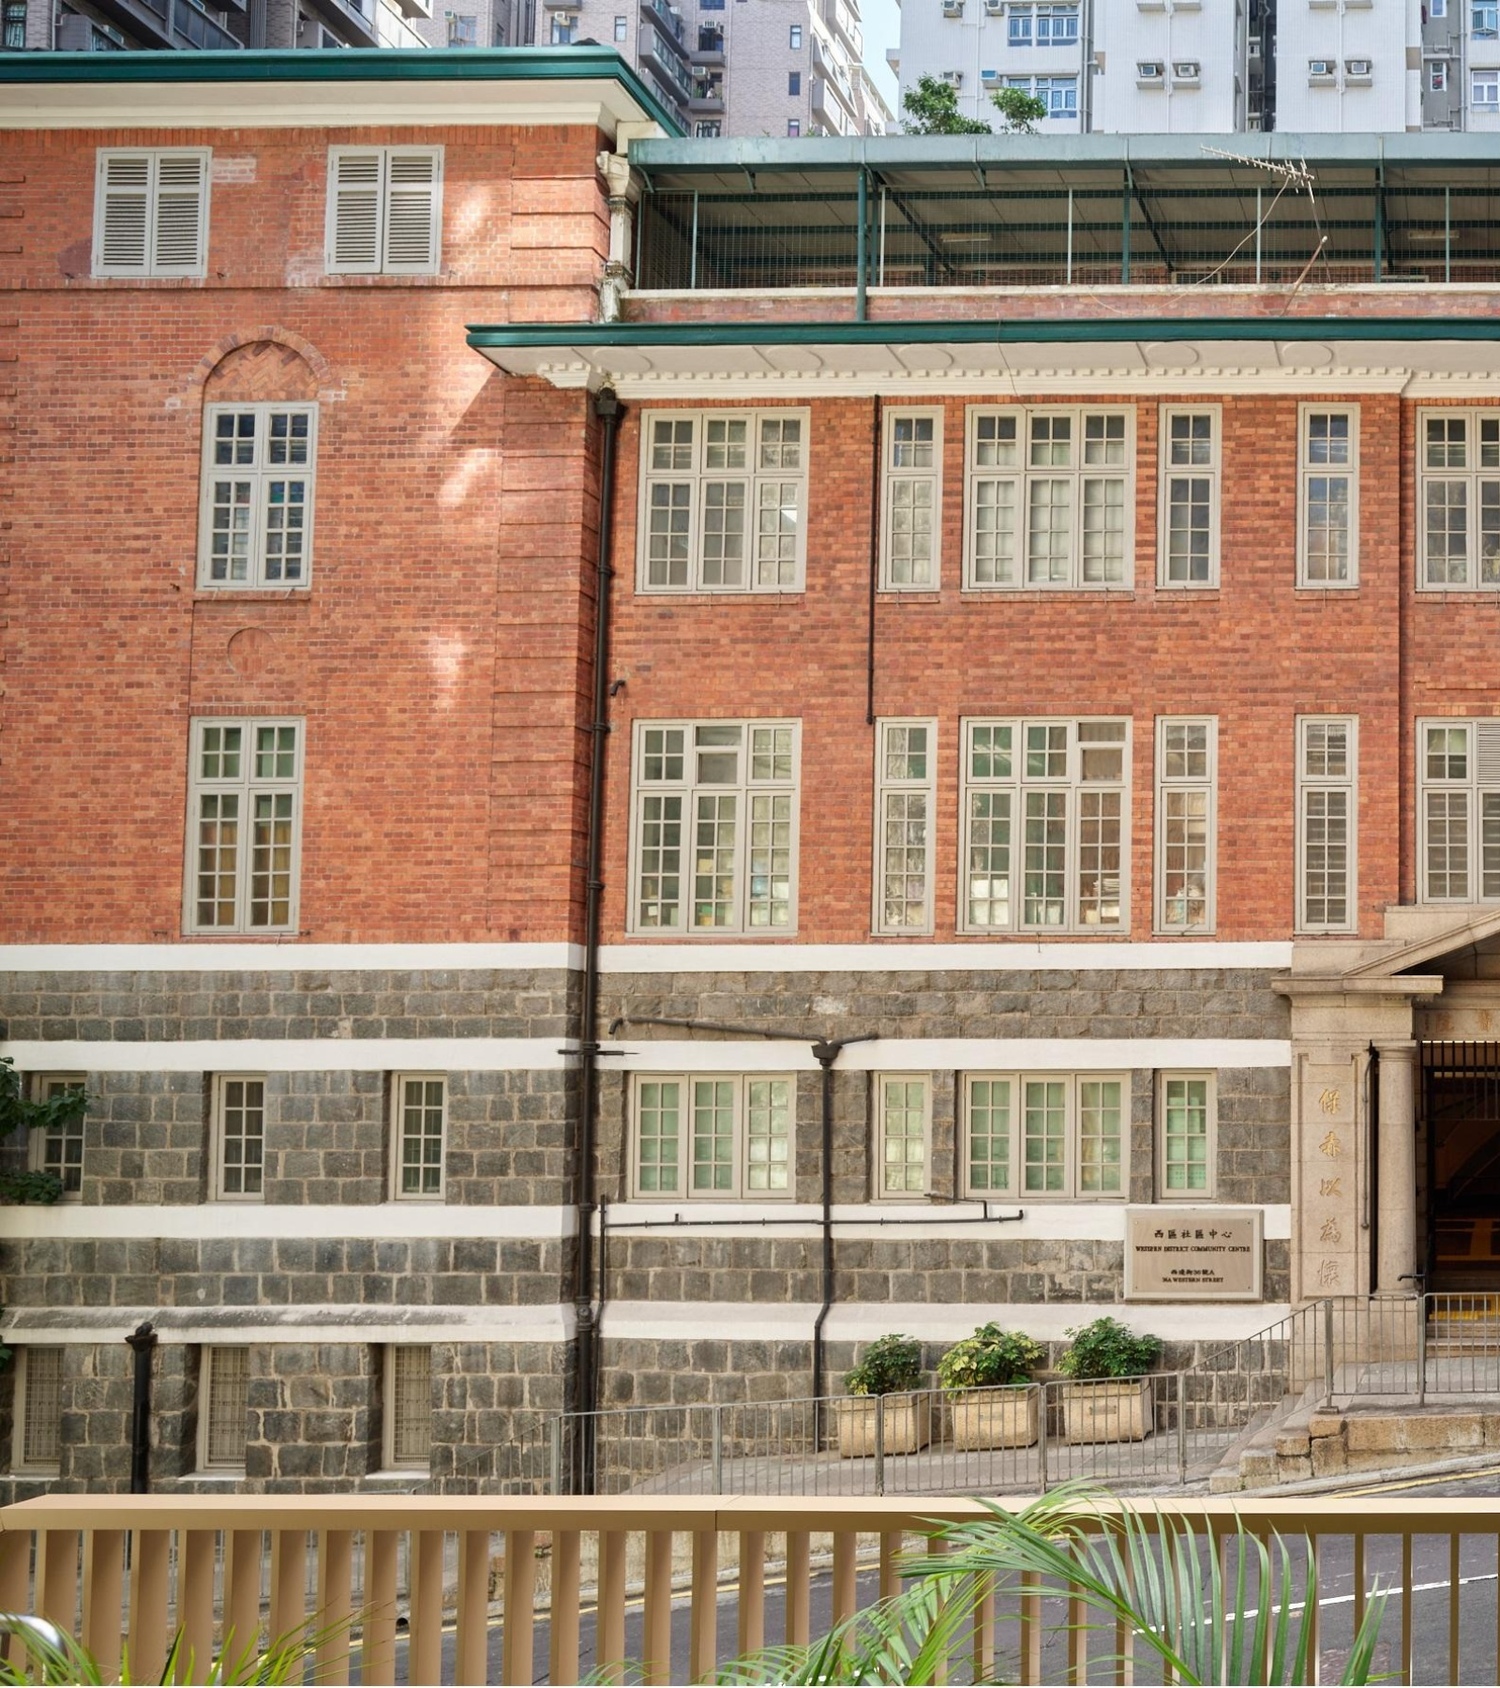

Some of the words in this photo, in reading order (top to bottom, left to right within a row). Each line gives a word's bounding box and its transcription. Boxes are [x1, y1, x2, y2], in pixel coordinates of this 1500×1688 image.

[1154, 1229, 1232, 1239] 西區社區中心
